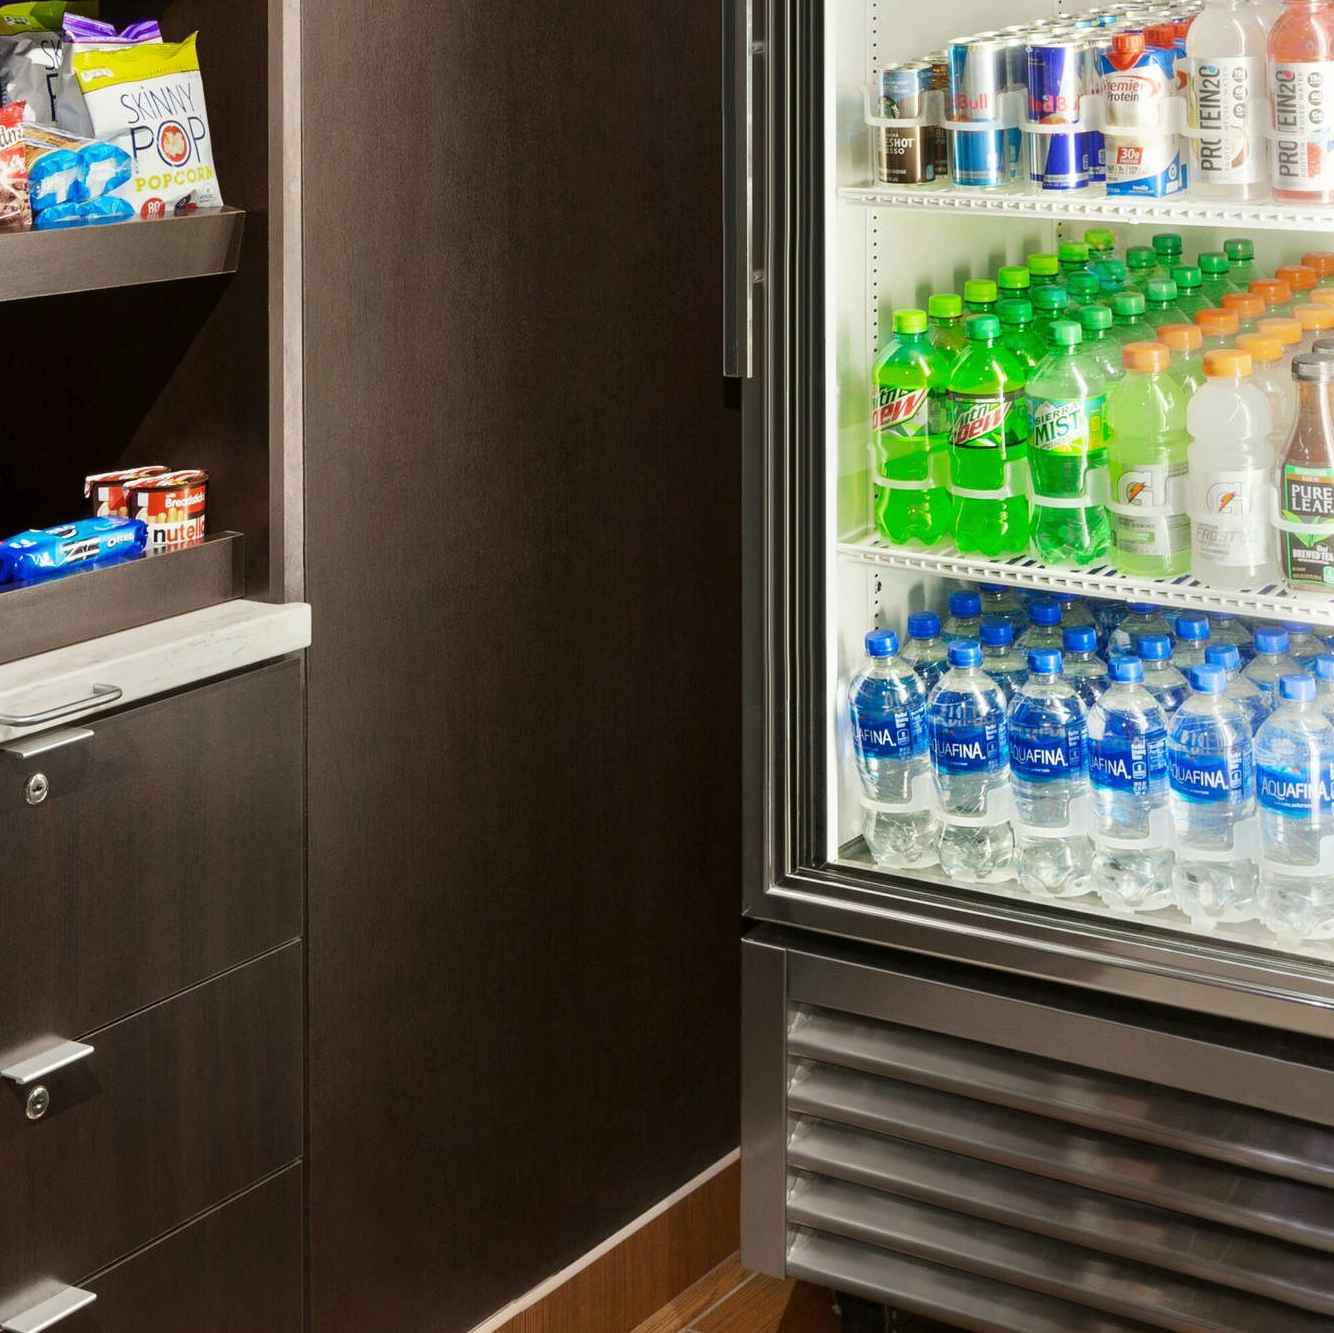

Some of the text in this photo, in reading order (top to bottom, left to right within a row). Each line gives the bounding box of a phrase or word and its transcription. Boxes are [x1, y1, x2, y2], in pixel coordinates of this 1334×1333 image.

[121, 82, 195, 124] SKINNY
[131, 116, 206, 172] POP
[135, 166, 213, 192] POPCORN
[1035, 404, 1078, 423] SIERRA
[1035, 411, 1083, 446] MIST
[1291, 483, 1333, 501] PURE
[107, 532, 134, 548] OREO
